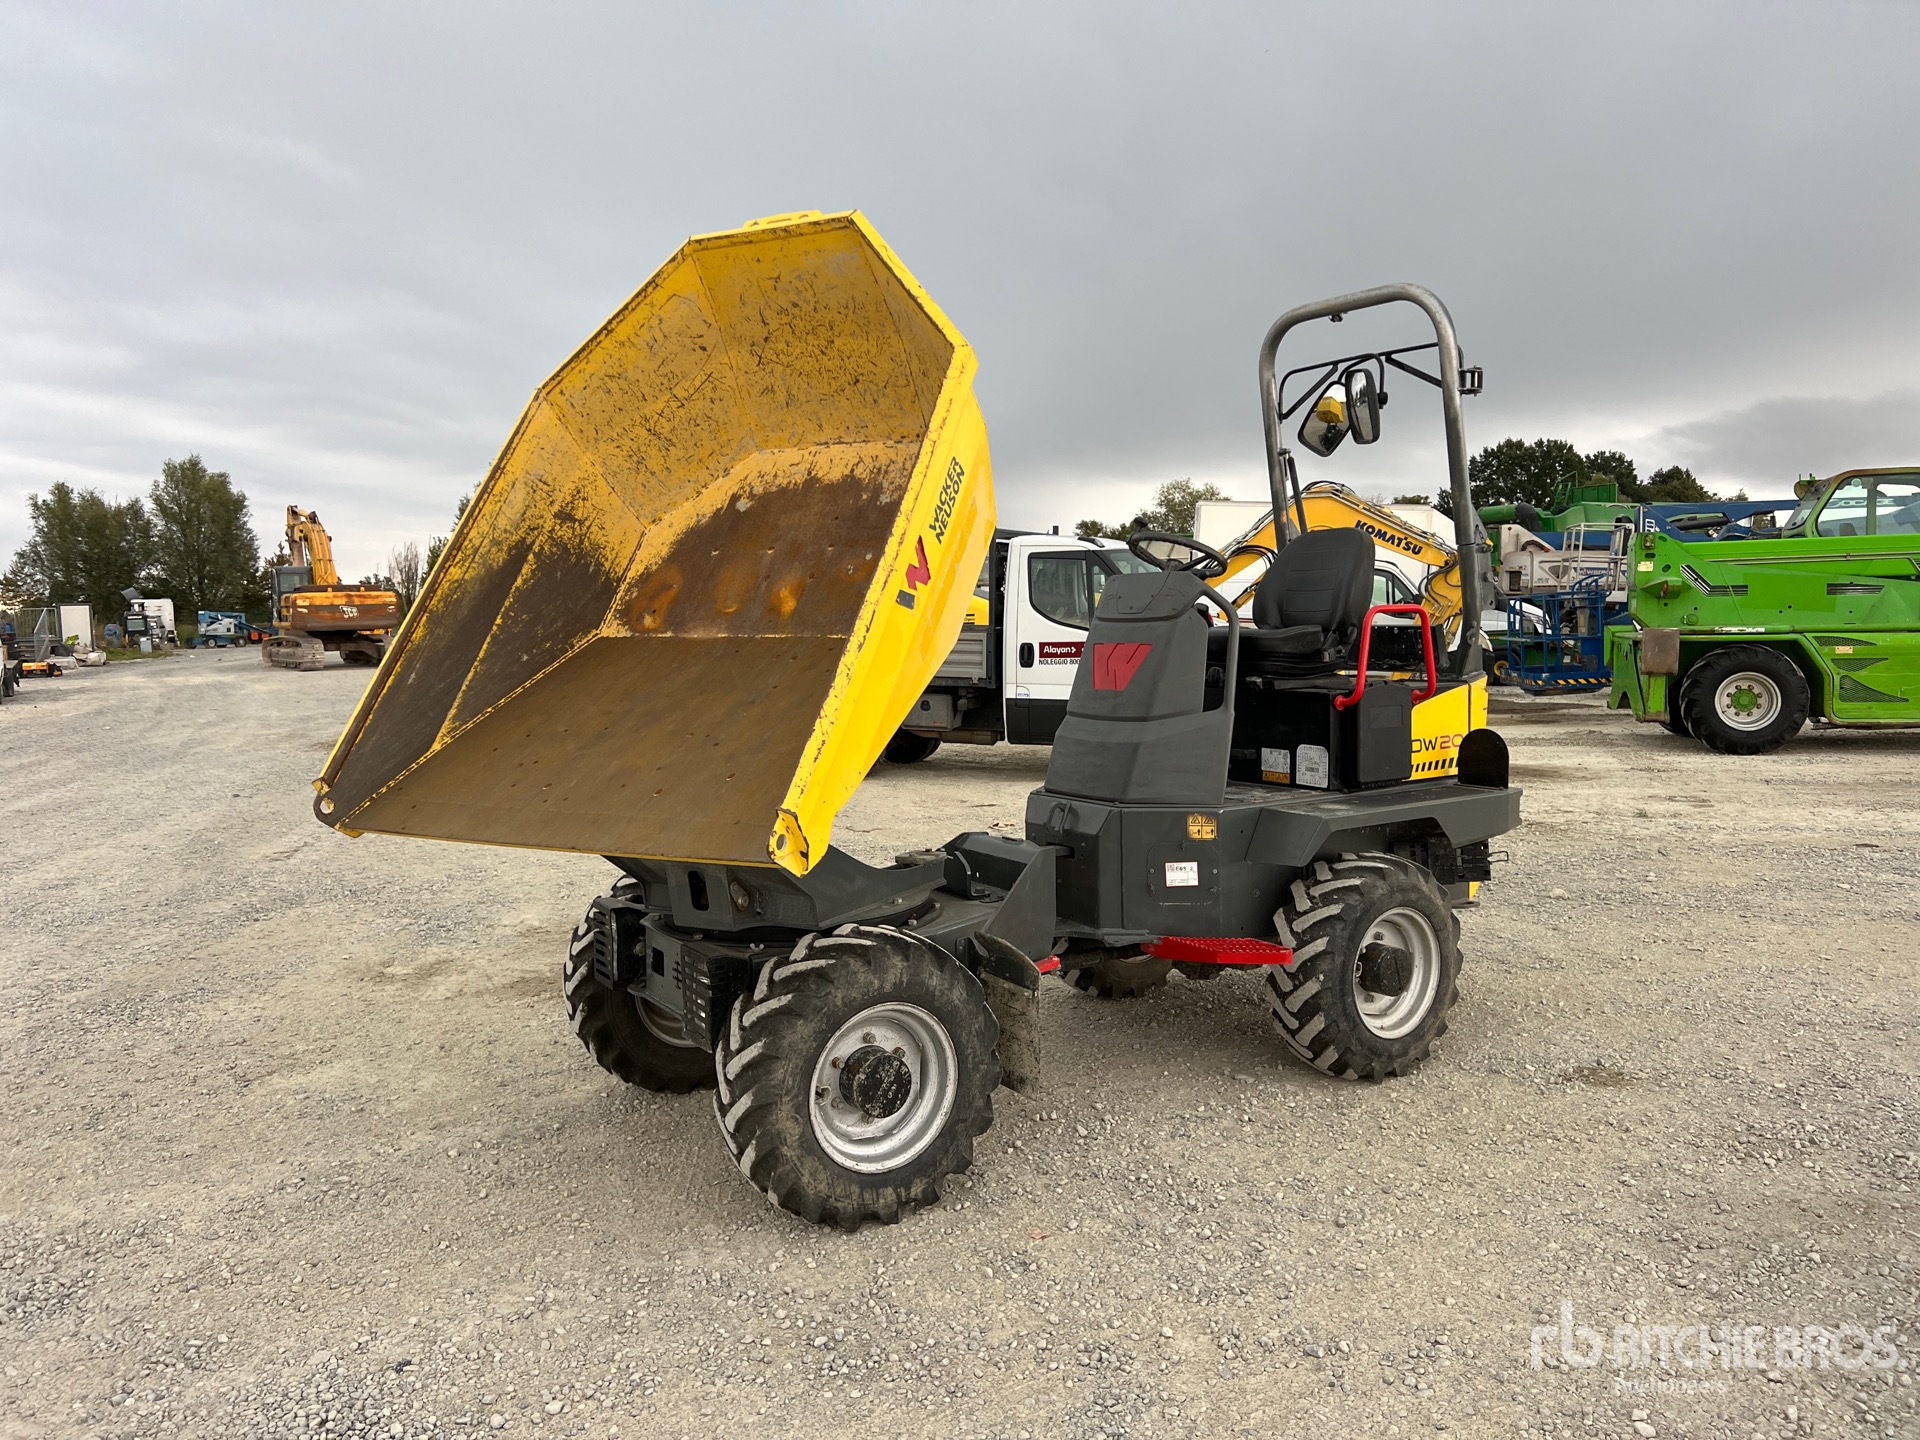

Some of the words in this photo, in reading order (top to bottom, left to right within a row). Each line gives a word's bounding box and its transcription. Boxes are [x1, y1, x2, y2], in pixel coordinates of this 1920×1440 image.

[929, 456, 959, 531] WACKER
[935, 464, 965, 545] NEUSON
[1355, 520, 1423, 555] KOMATSU
[1043, 645, 1070, 655] Alayan
